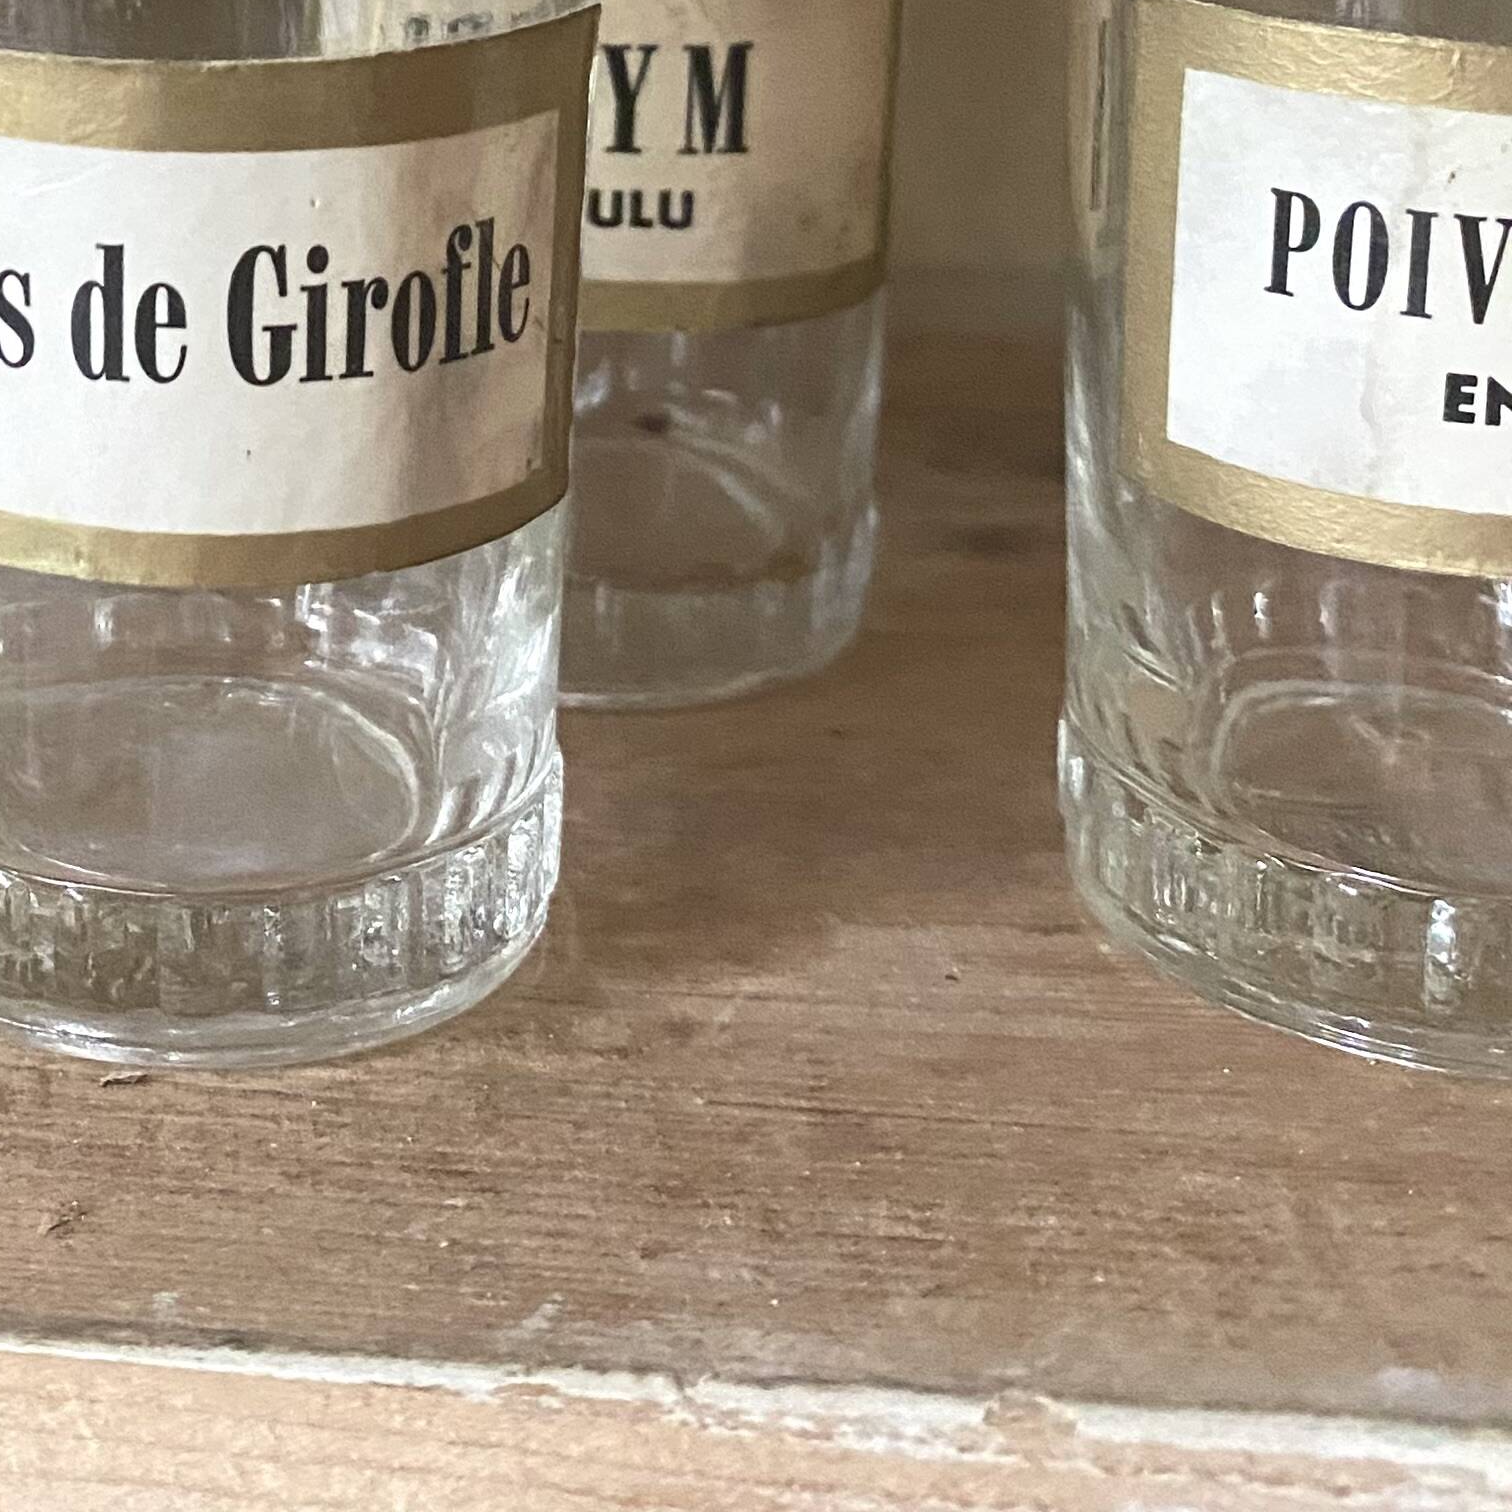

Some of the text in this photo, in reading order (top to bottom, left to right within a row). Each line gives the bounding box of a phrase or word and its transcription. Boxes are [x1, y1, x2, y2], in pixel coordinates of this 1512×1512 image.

[70, 243, 188, 384] de
[227, 217, 532, 387] Girofle
[1263, 187, 1512, 325] POIV
